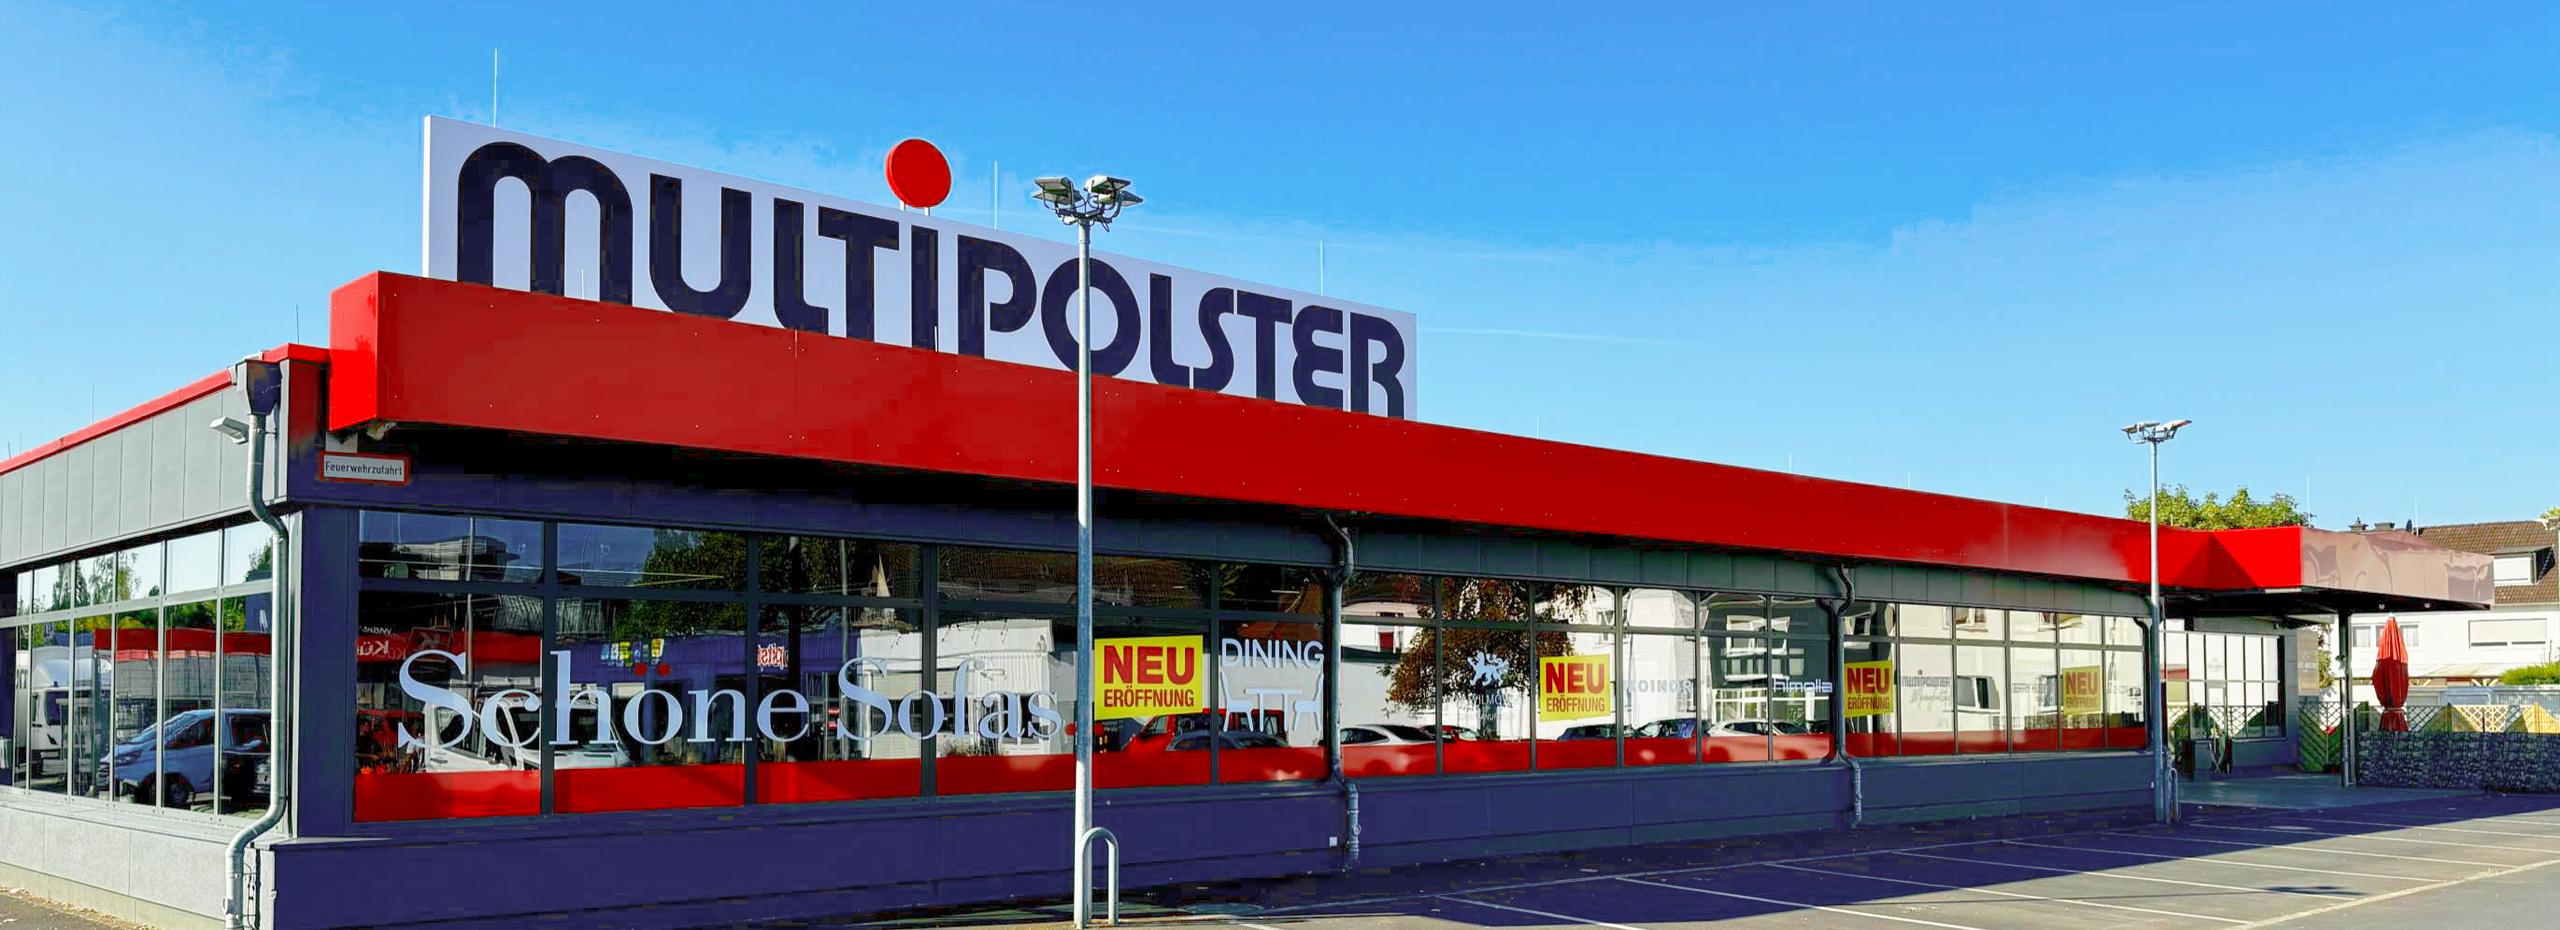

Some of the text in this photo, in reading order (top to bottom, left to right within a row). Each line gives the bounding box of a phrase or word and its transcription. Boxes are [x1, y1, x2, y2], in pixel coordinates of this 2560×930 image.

[325, 461, 403, 476] Feuerwehrzufahrt
[1104, 645, 1195, 685] NEU
[1221, 638, 1325, 669] DINING
[1546, 662, 1605, 694] NEU
[1847, 667, 1890, 695] NEU
[2065, 672, 2099, 696] NEU
[398, 650, 809, 749] Schöne
[1104, 685, 1195, 708] ERÖFFNUNG
[1546, 694, 1605, 713] ERÖFFNUNG
[1848, 695, 1891, 710] ERÖFFNUNG
